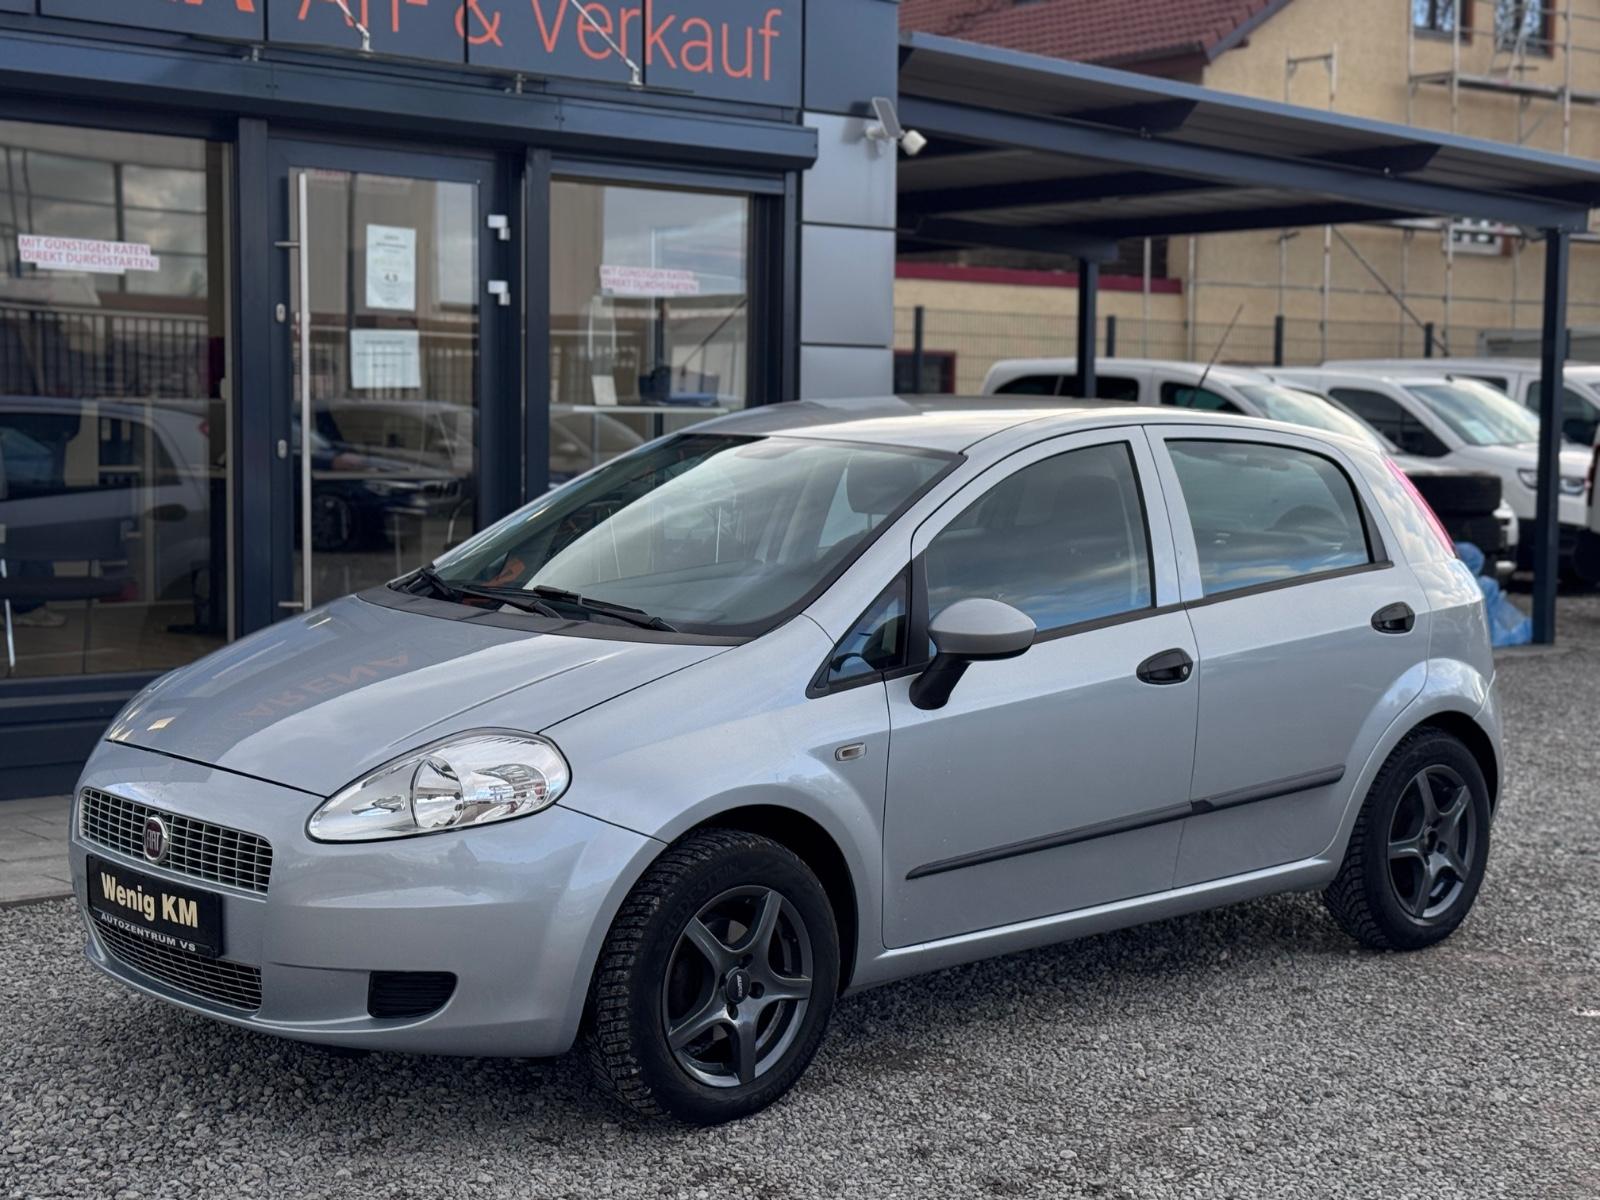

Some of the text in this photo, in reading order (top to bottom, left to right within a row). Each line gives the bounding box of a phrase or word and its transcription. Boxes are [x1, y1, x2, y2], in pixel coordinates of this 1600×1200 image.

[454, 0, 503, 47] &
[531, 0, 783, 81] Verkauf
[147, 829, 160, 851] FIAT
[101, 871, 199, 928] Wenig KM
[100, 911, 197, 952] AUTOZENTRUM VS
